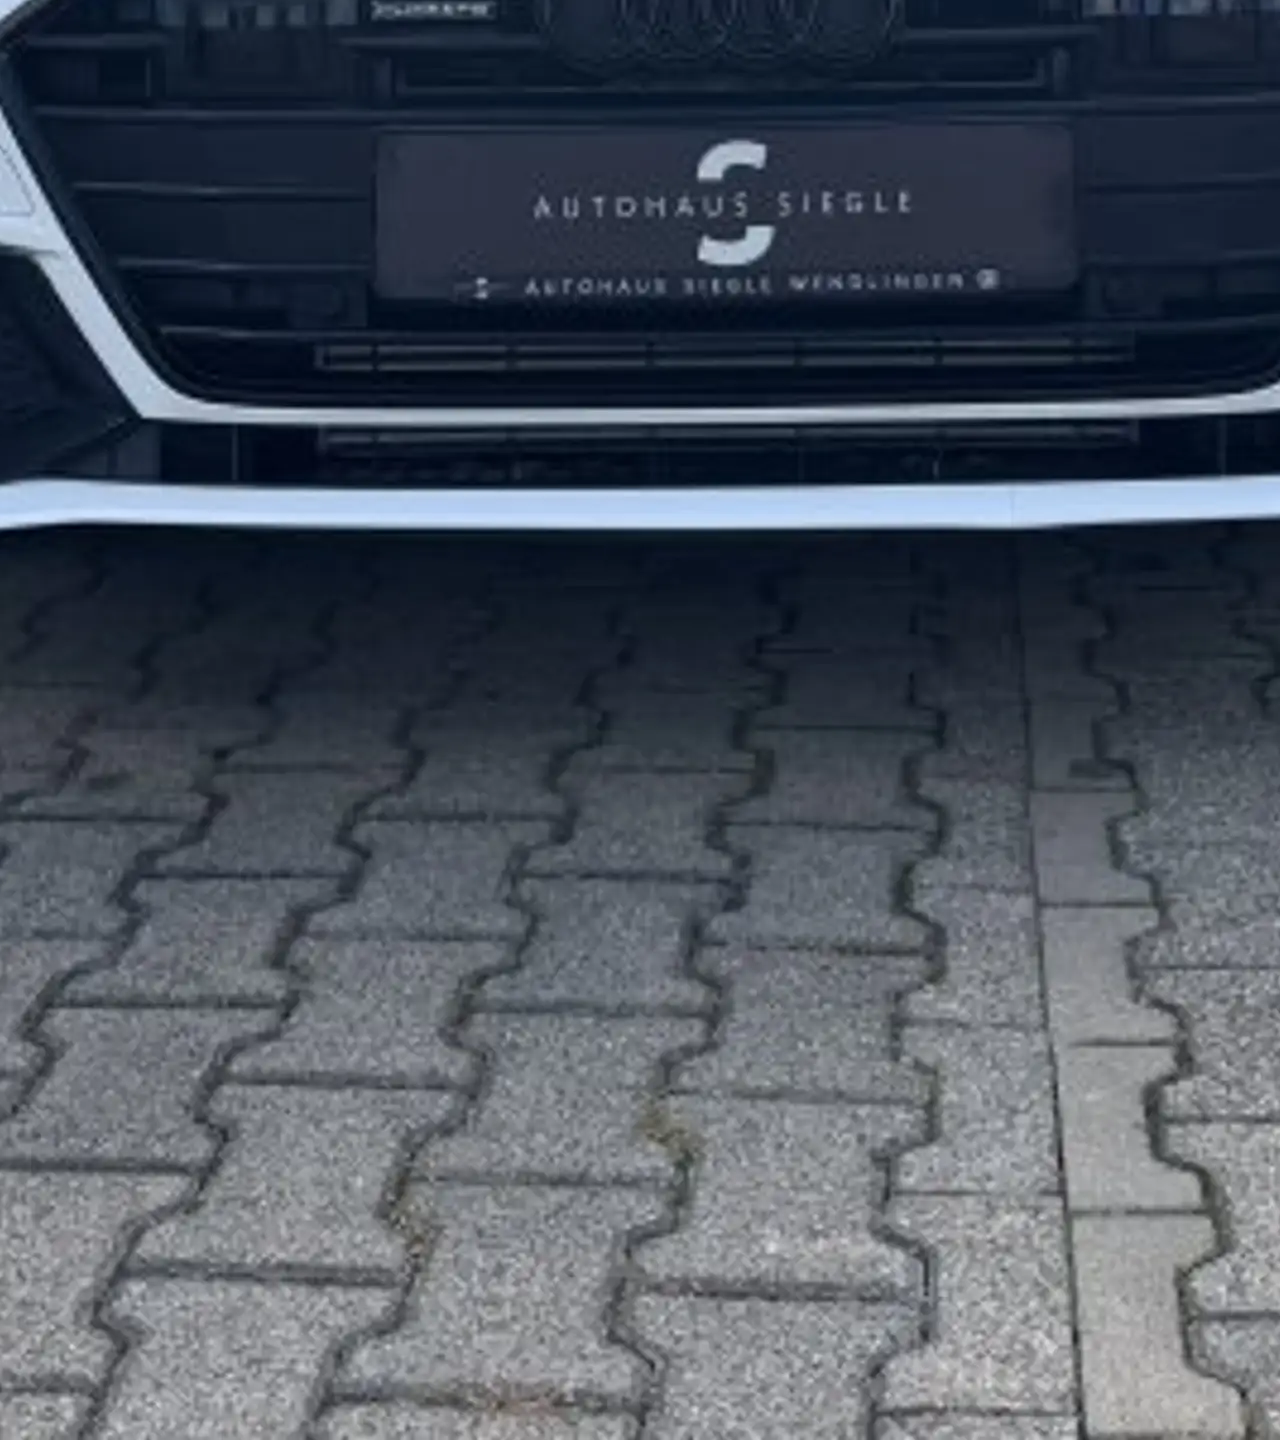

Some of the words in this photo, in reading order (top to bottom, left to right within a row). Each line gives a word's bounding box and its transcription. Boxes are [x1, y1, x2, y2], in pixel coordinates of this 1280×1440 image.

[533, 191, 749, 220] AUTOHAUS
[777, 189, 912, 218] SIEGLE
[524, 277, 668, 297] AUTOHAUS
